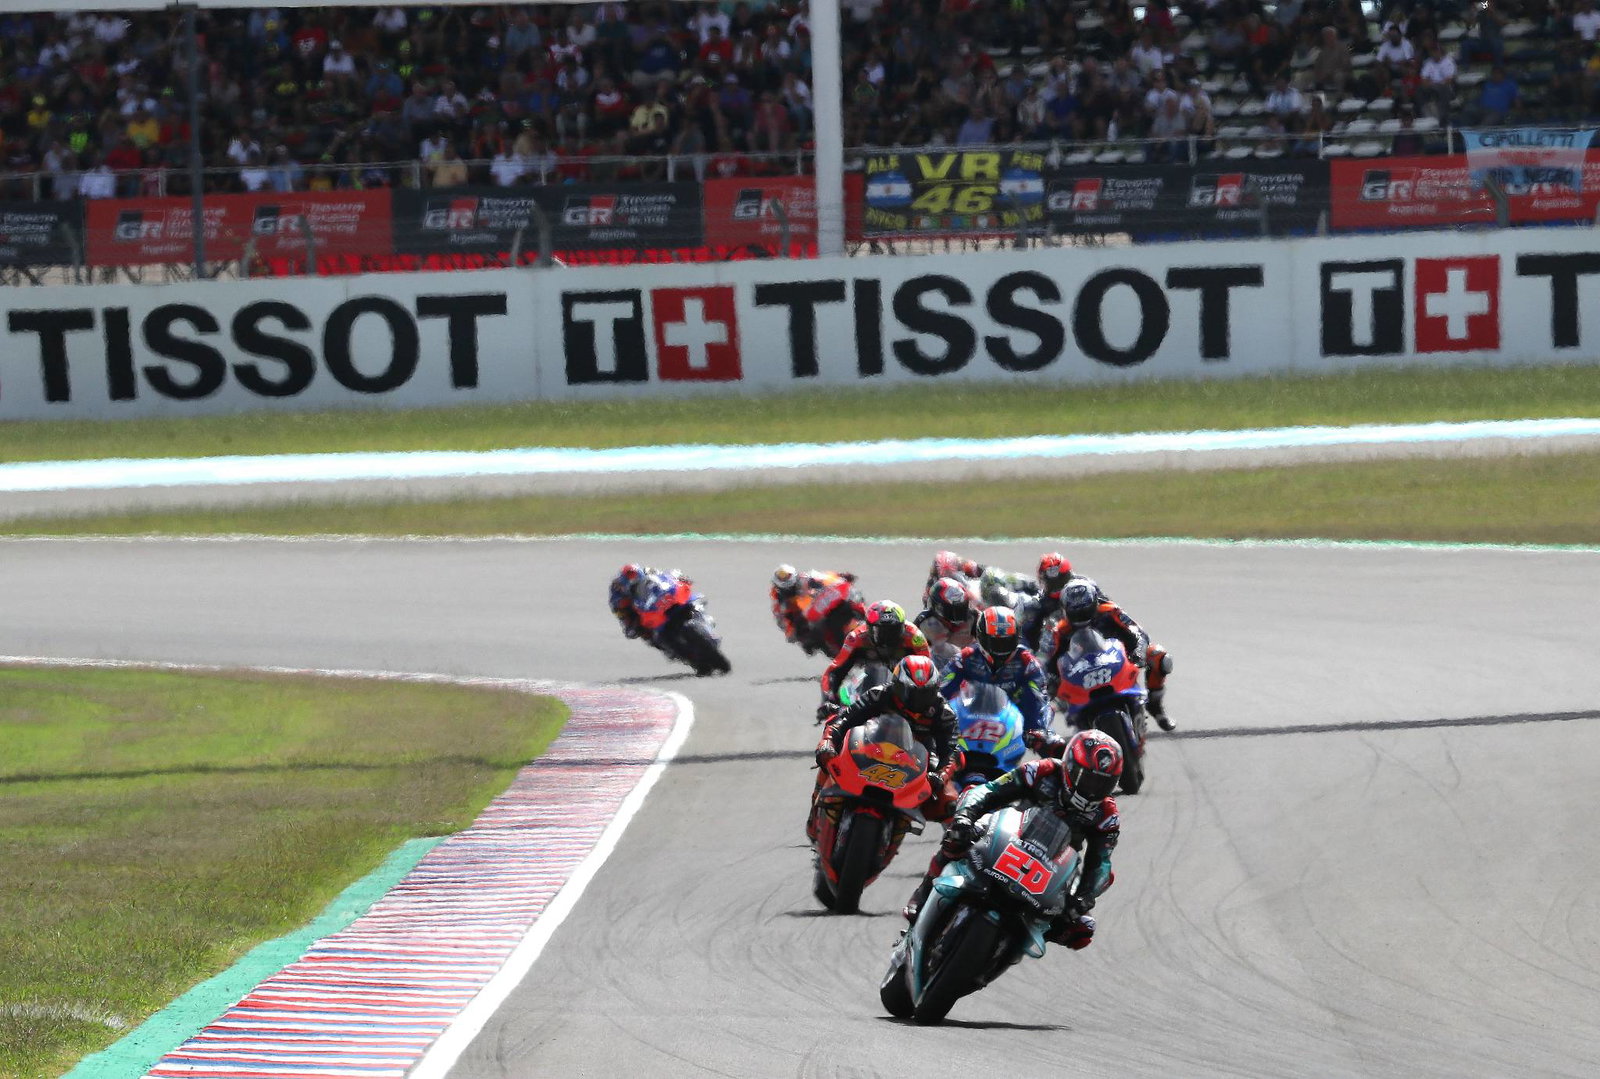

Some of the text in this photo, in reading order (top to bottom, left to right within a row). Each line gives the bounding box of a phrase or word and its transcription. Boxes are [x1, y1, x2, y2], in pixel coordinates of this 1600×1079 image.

[915, 152, 1001, 181] VR
[911, 184, 998, 214] 46
[1049, 191, 1099, 210] GR
[1190, 186, 1241, 207] GR
[1361, 181, 1413, 199] GR
[425, 208, 475, 228] GR
[564, 206, 614, 225] GR
[117, 221, 163, 240] GR
[756, 264, 1265, 378] TISSOT
[9, 292, 507, 404] TISSOT
[961, 719, 1006, 743] 42
[858, 764, 907, 791] 44
[1008, 836, 1059, 874] PETRONAS
[983, 868, 1009, 884] europe
[992, 842, 1054, 896] 20
[1021, 890, 1041, 908] energy
